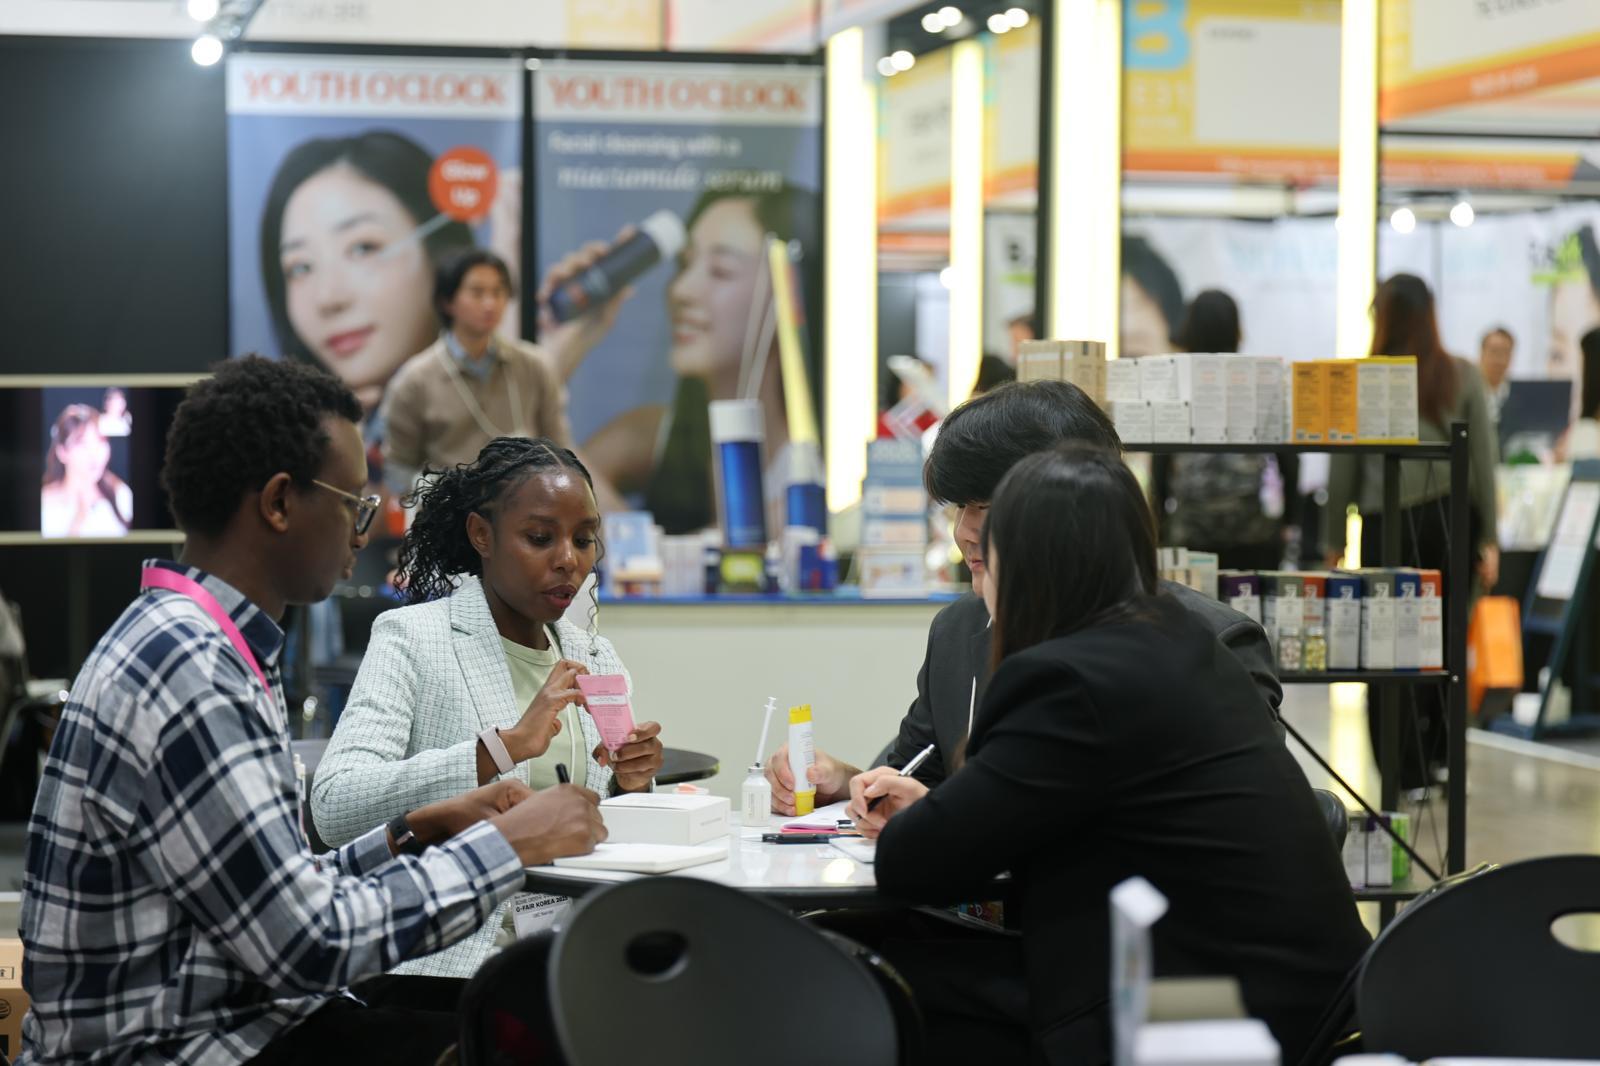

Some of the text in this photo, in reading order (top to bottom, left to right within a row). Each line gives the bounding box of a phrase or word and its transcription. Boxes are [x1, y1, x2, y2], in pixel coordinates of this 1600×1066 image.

[244, 71, 361, 104] YOUTH
[548, 74, 665, 111] YOUTH
[536, 898, 556, 908] KOREA
